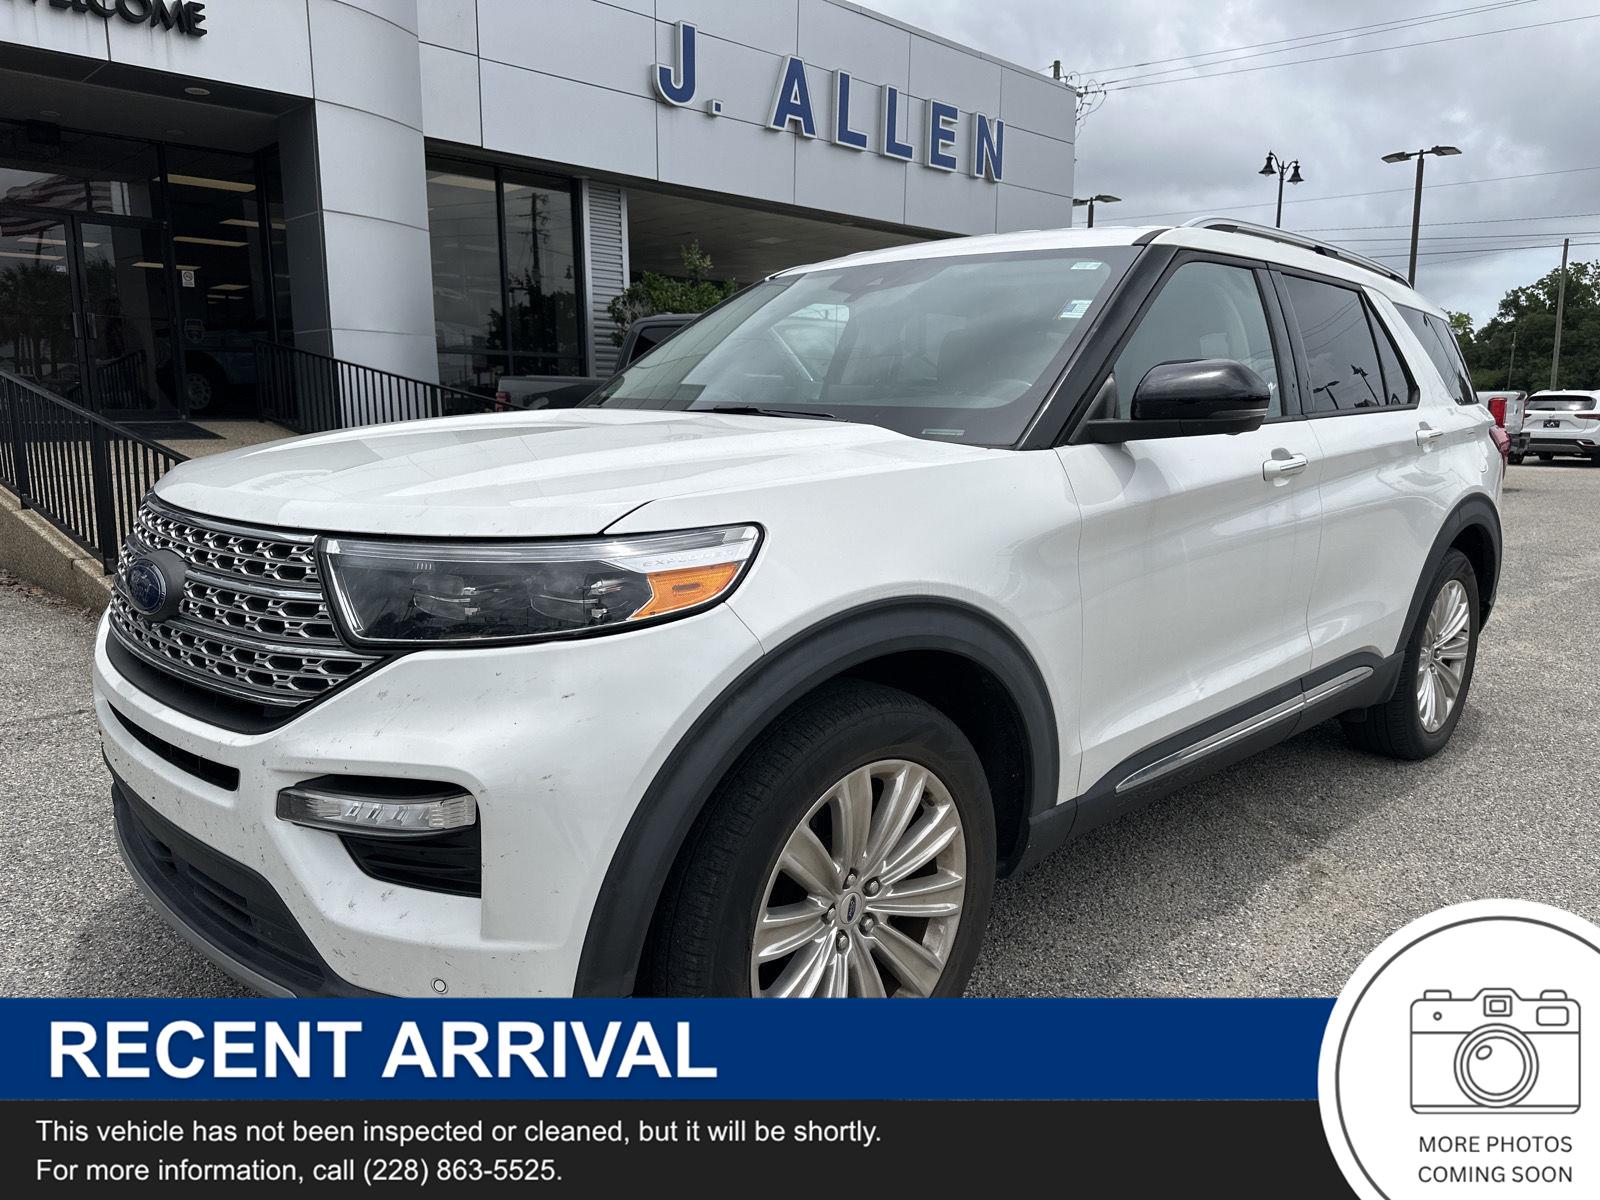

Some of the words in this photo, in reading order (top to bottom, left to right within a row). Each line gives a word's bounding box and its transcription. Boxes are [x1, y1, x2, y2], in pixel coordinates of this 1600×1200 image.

[4, 0, 207, 37] COME
[652, 20, 723, 116] J.
[766, 54, 1004, 183] ALLEN
